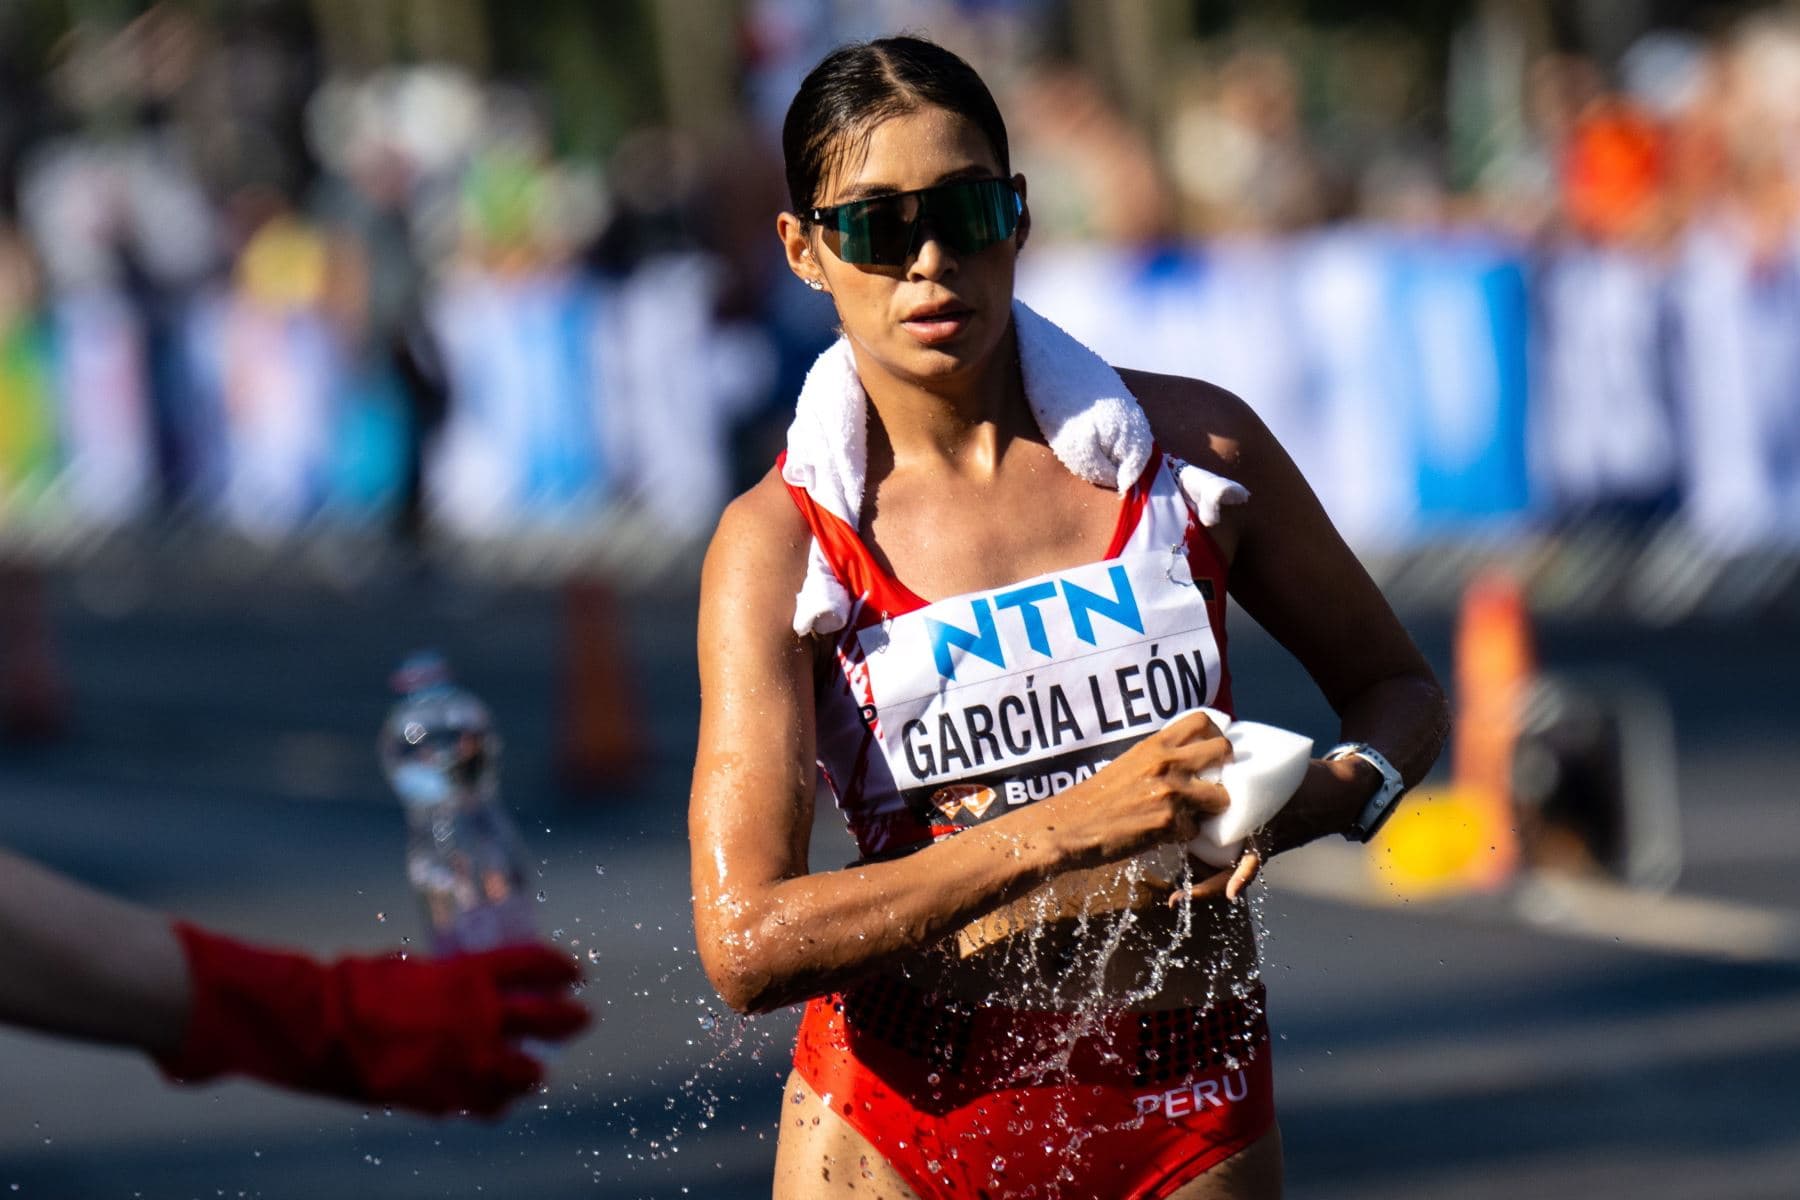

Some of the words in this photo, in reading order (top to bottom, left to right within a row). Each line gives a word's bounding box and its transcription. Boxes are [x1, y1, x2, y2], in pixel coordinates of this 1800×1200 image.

[924, 565, 1145, 681] NTN
[902, 676, 1084, 782] GARCÍA
[1089, 645, 1207, 734] LEÓN
[1005, 760, 1112, 805] BUDA
[1133, 1071, 1249, 1123] PERU
